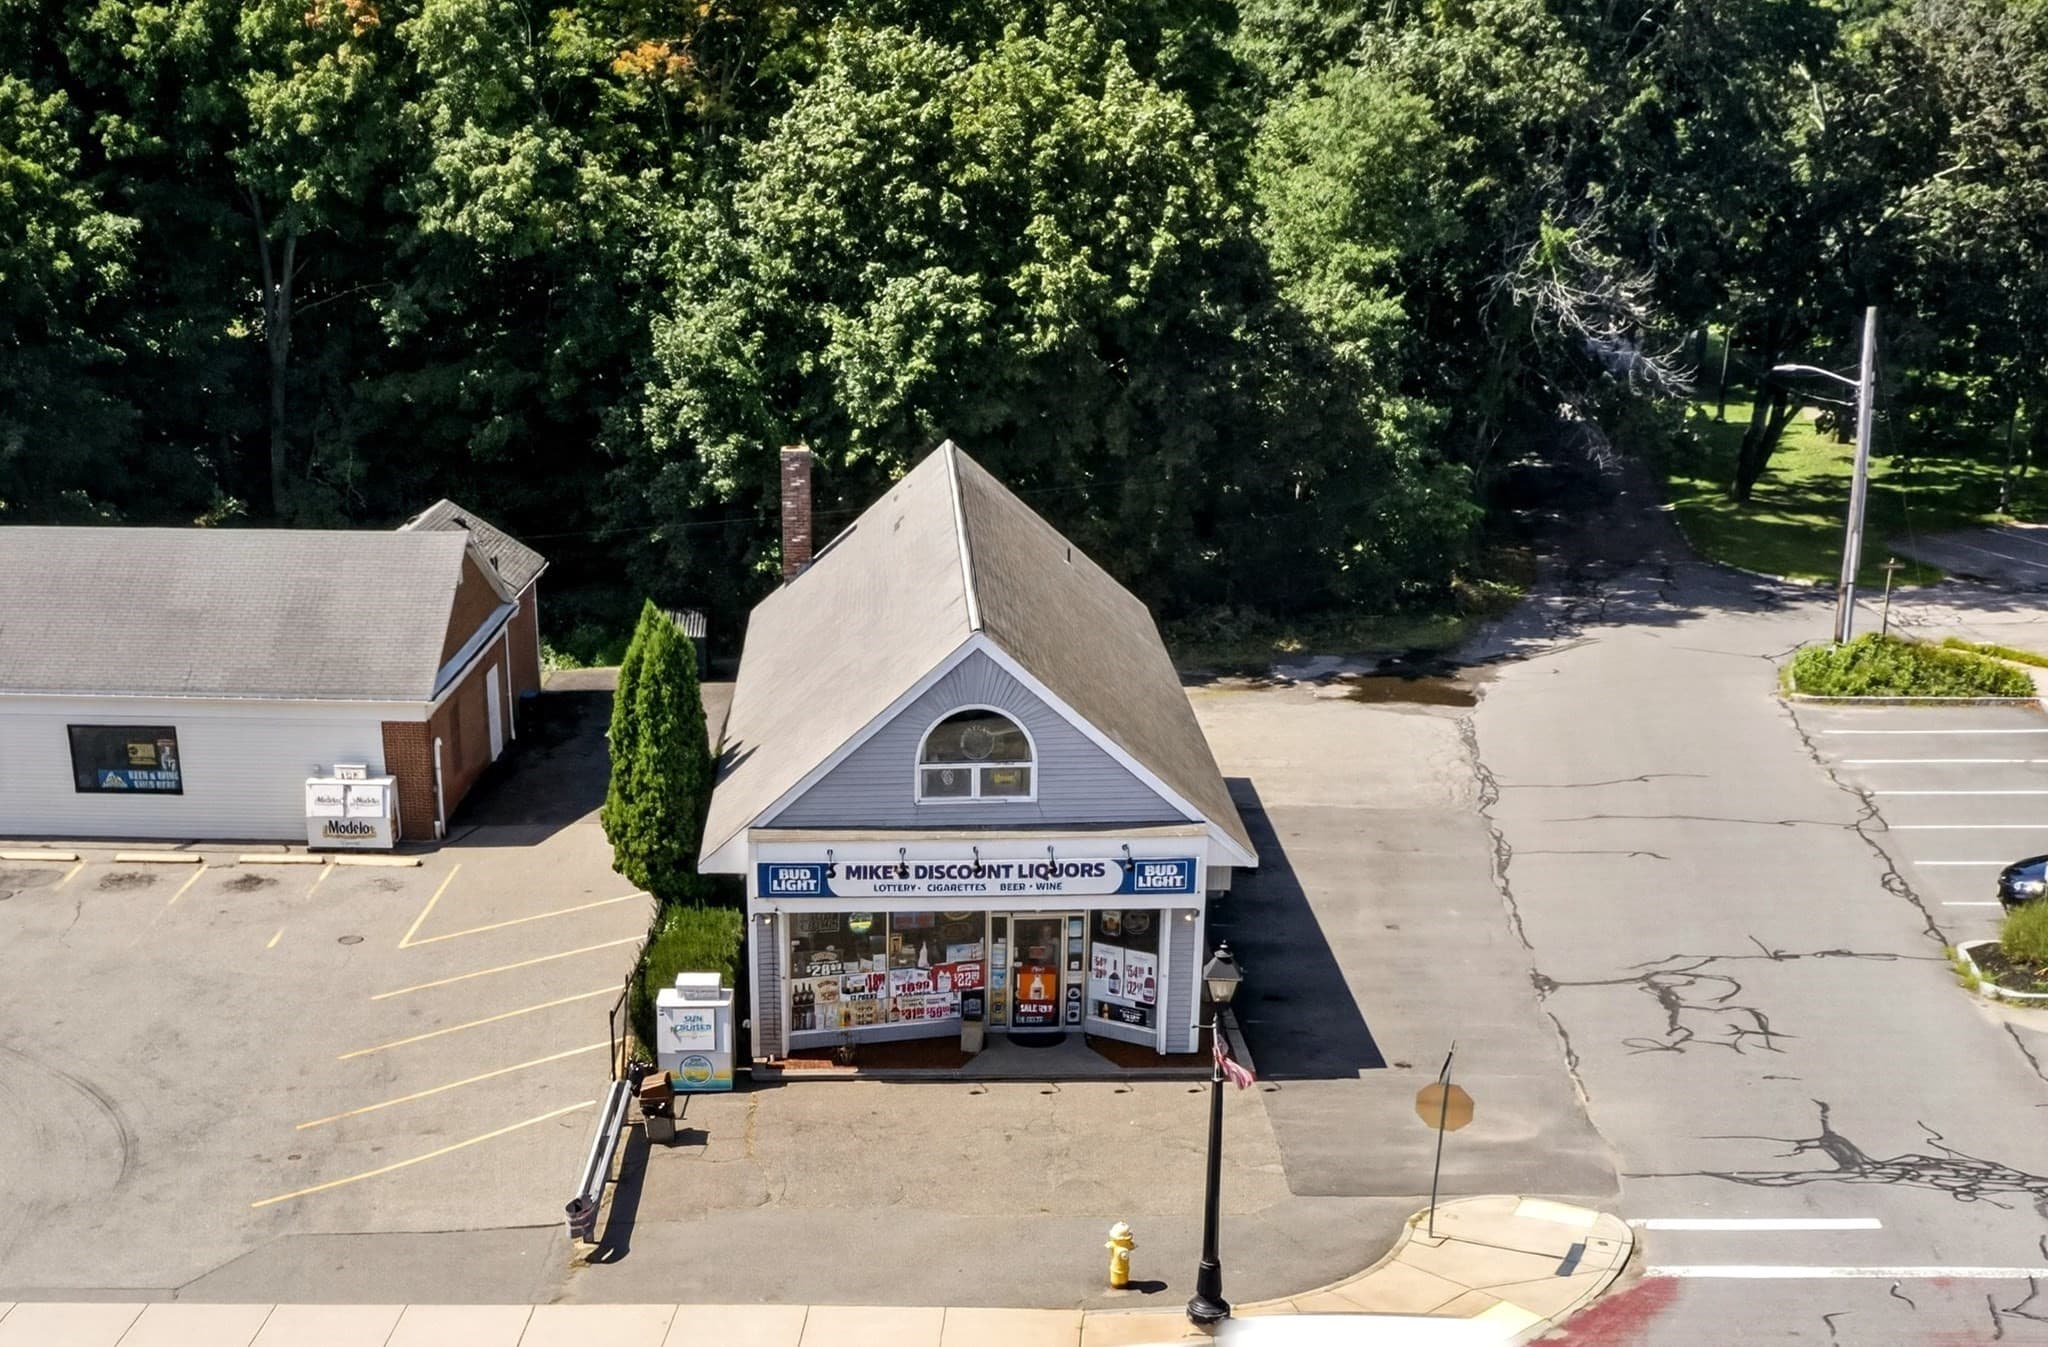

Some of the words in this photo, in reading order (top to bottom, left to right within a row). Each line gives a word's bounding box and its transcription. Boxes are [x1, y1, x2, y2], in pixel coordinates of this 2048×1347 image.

[328, 820, 370, 835] Modelo
[779, 868, 811, 880] BUD
[914, 863, 1014, 880] DISCOUNT
[1017, 862, 1106, 881] LIQUORS
[1144, 863, 1178, 877] BUD
[772, 879, 817, 892] LIGHT
[873, 884, 916, 893] LOTTERY
[926, 883, 987, 893] CIGARETTES
[1000, 883, 1026, 892] BEER
[1036, 882, 1063, 891] WINE
[1138, 875, 1185, 888] LIGHT
